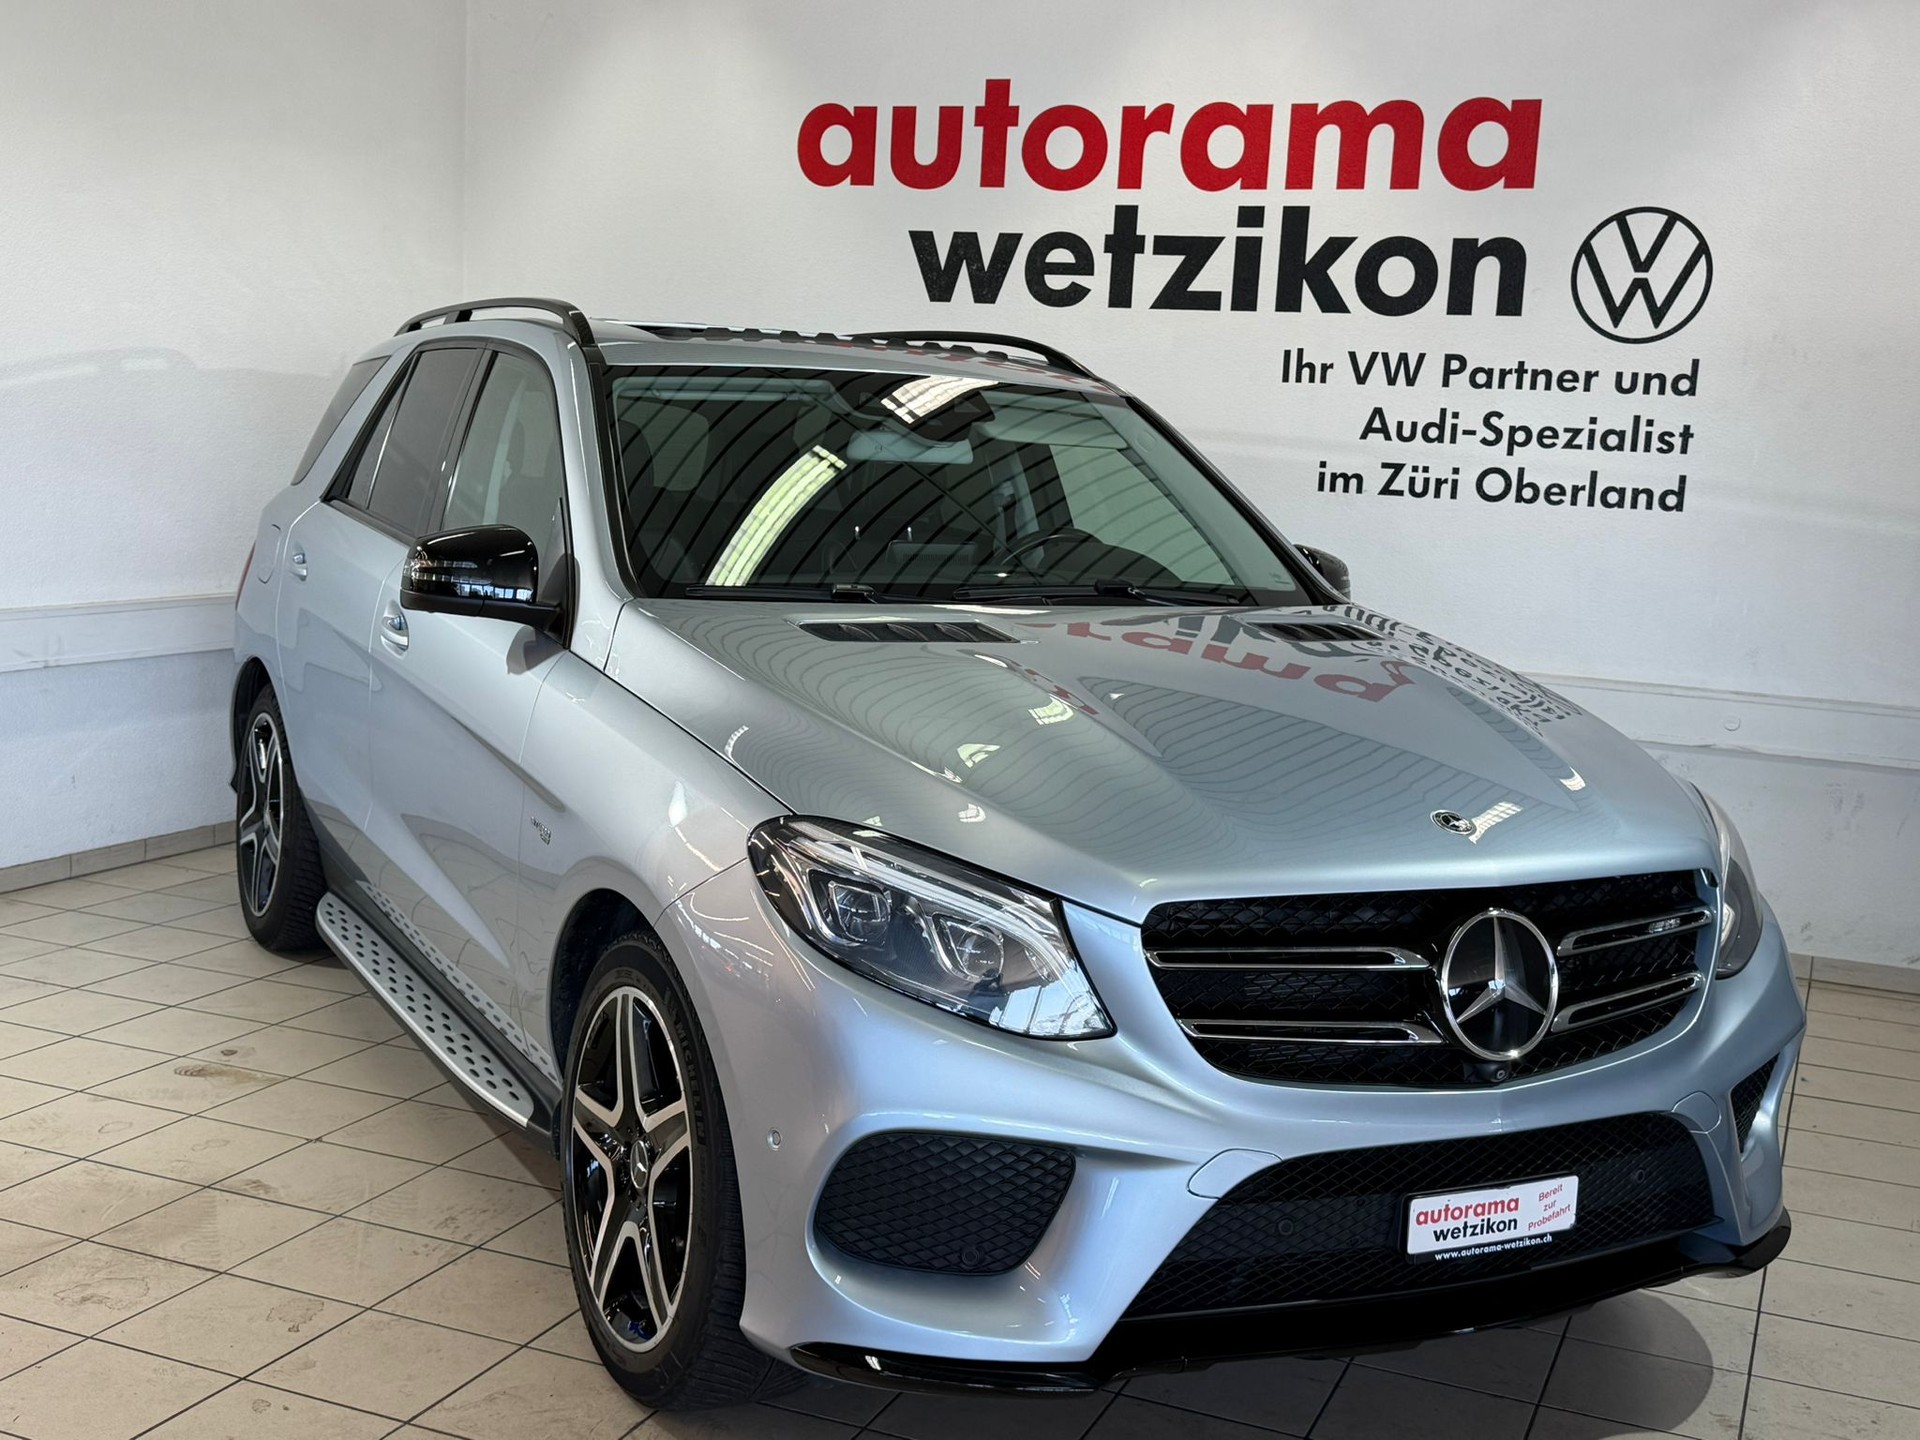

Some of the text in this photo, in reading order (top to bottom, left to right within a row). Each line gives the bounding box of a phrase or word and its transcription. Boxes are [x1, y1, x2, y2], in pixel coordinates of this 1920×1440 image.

[797, 79, 1543, 193] autorama
[908, 204, 1527, 318] wetzikon
[1281, 348, 1700, 398] Ihr VW Partner und
[1359, 405, 1695, 456] Audi-Spezialist
[1317, 460, 1687, 513] im Züri Oberland
[1538, 1183, 1563, 1202] Bereit
[1543, 1199, 1557, 1212] zur
[1415, 1197, 1520, 1226] autorama
[1527, 1203, 1571, 1231] Probefahrt
[1432, 1217, 1518, 1242] wetzikon
[1434, 1232, 1553, 1261] www.autorama-wetzikon.ch
